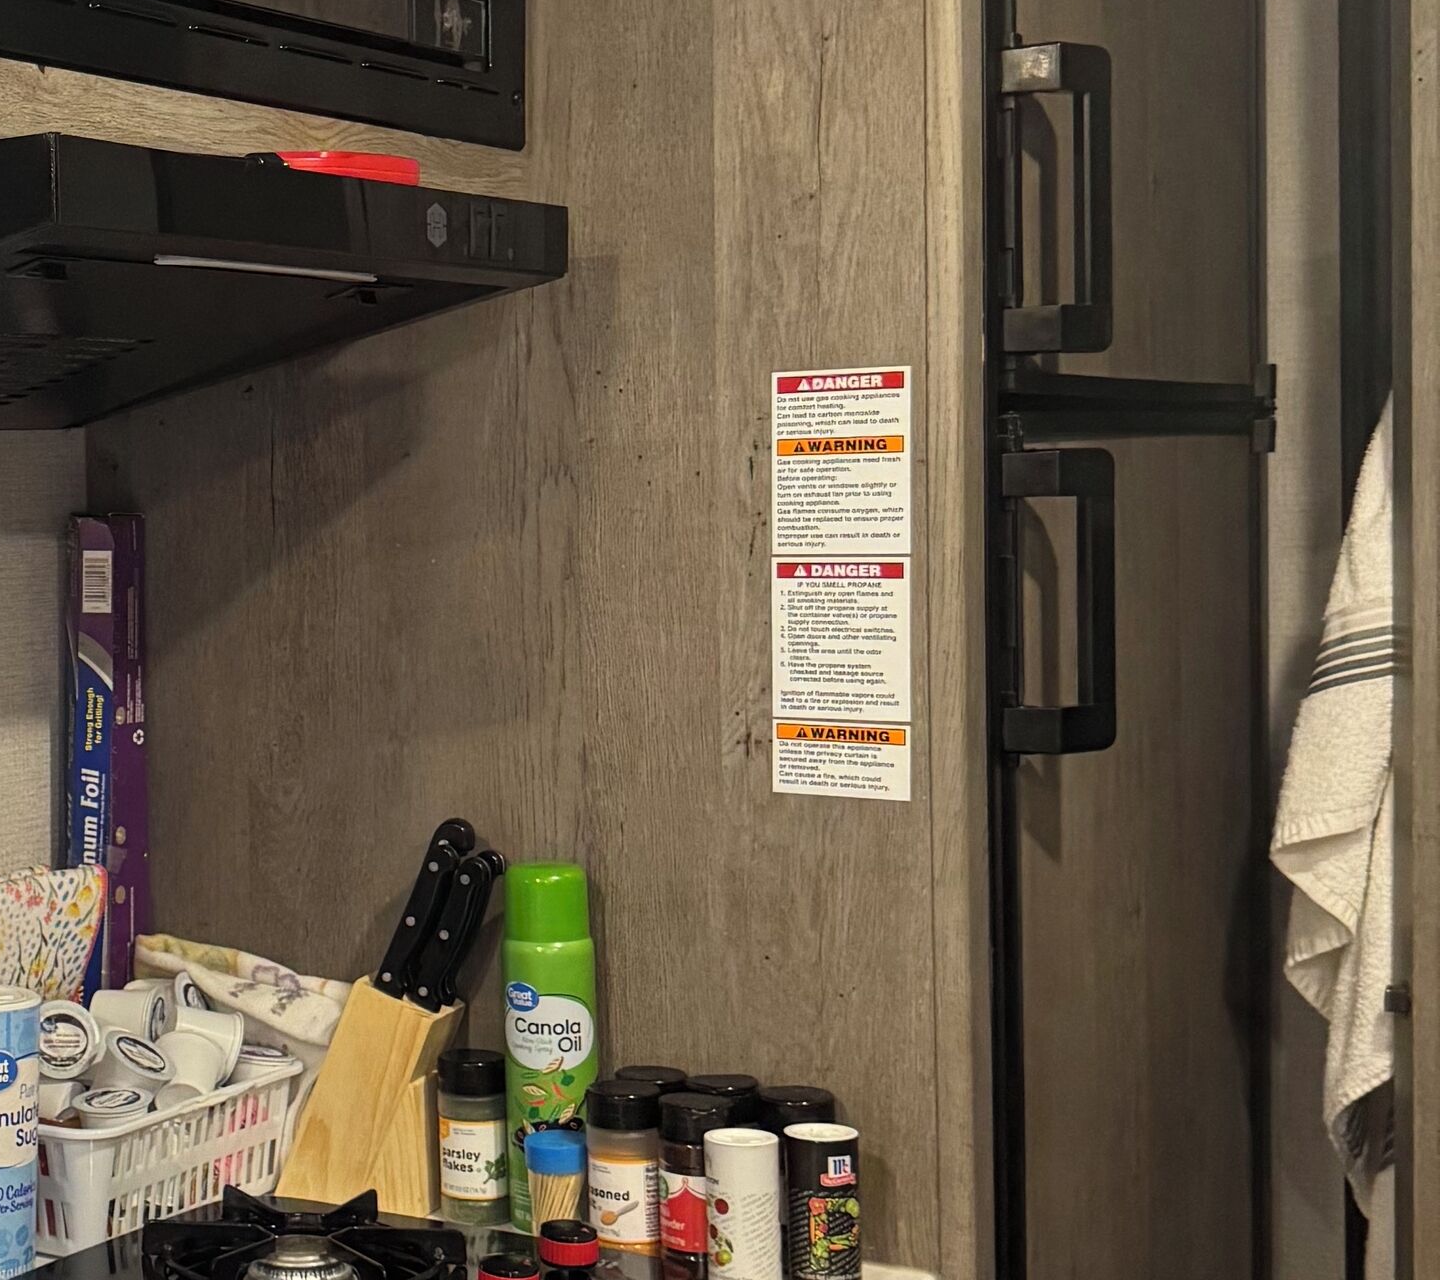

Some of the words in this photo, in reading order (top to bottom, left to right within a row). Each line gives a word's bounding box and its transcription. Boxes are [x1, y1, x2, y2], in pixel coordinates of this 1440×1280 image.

[812, 375, 883, 390] DANGER
[808, 439, 887, 452] WARNING
[811, 565, 880, 576] DANGER
[811, 728, 890, 742] WARNING
[80, 768, 100, 809] Foil
[508, 987, 532, 1001] Great
[515, 1017, 582, 1036] Canola
[558, 1036, 582, 1053] Oil
